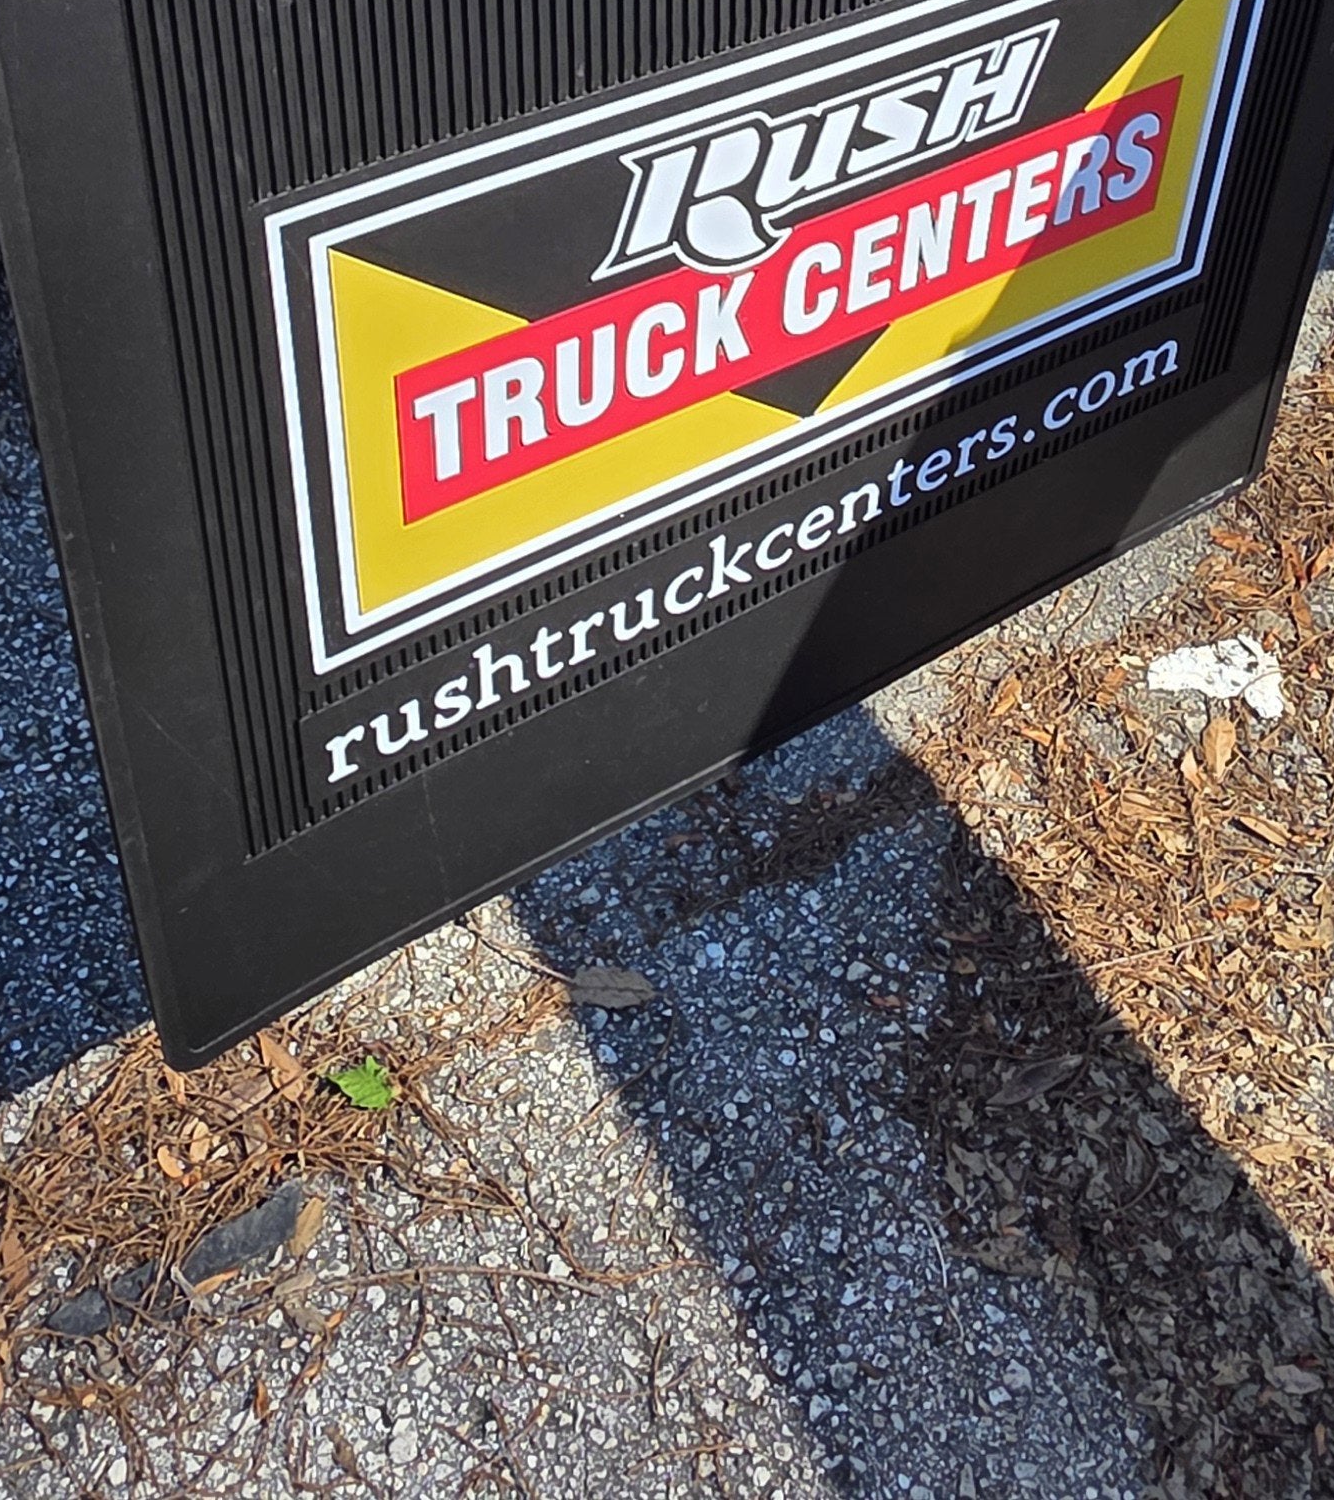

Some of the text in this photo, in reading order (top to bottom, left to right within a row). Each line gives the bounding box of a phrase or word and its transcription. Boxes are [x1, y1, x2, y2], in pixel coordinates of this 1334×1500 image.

[413, 112, 1163, 483] TRUCK CENTERS
[324, 338, 1179, 782] rushtruckcenters.com
